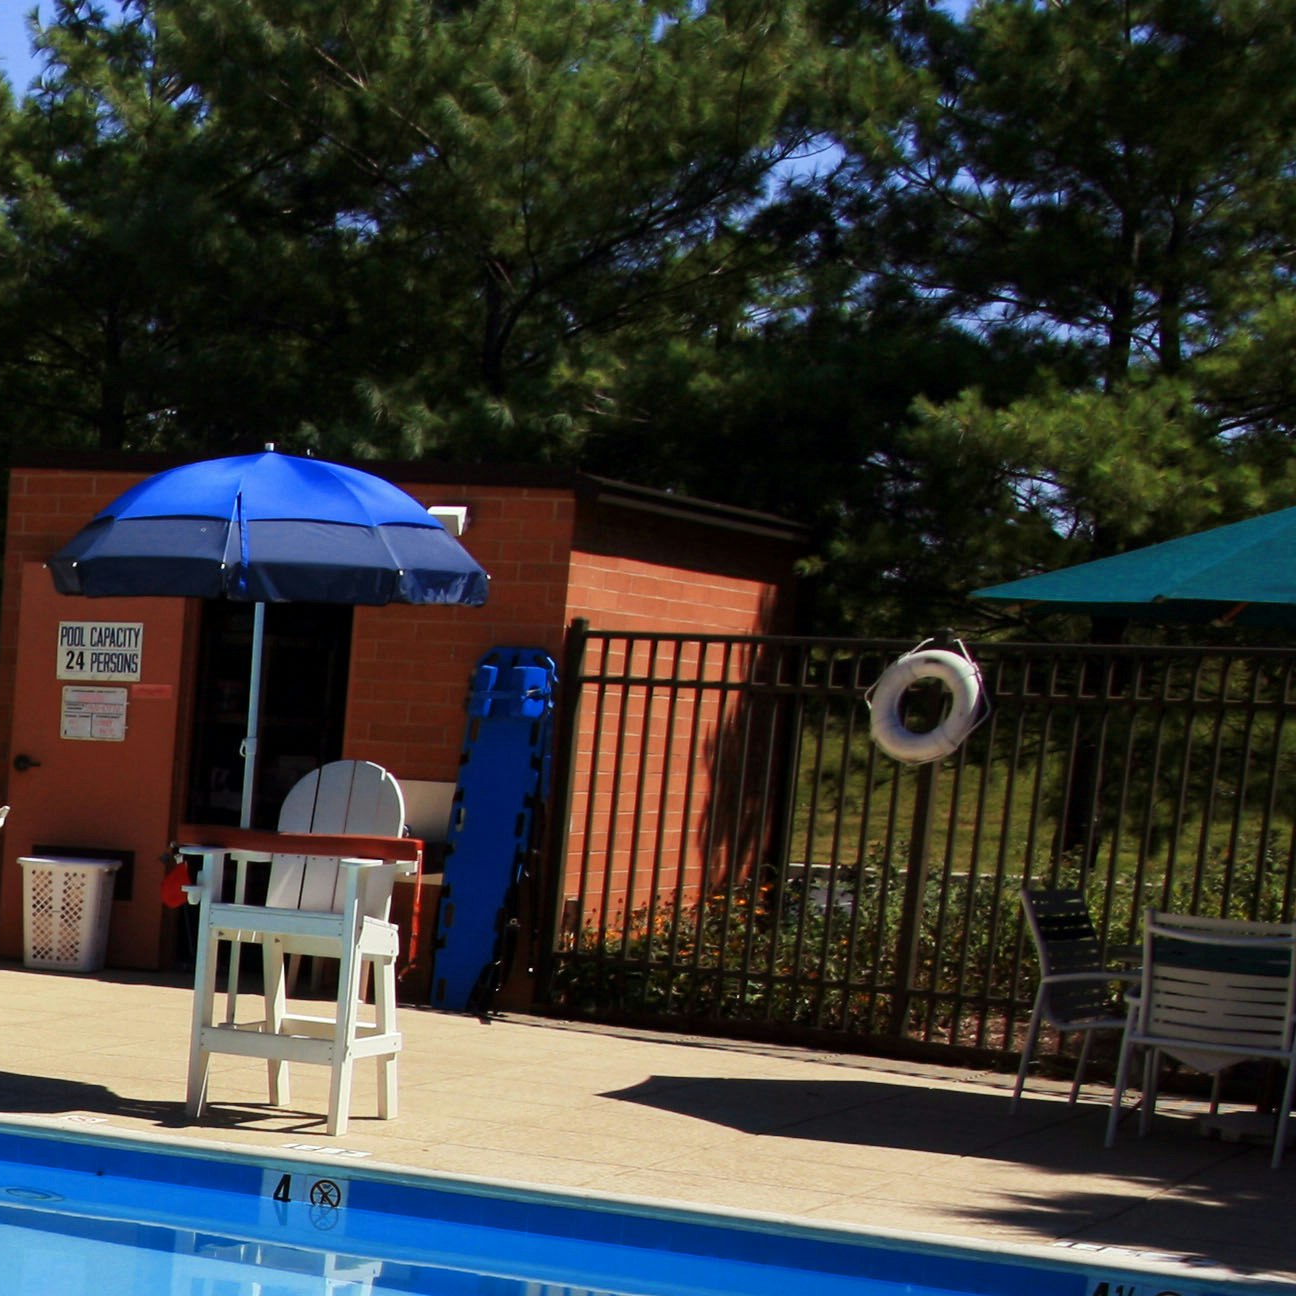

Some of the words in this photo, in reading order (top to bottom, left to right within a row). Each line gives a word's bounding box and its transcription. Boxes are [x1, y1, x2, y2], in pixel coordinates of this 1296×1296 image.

[60, 625, 86, 647] POOL
[90, 626, 141, 649] CAPACITY
[65, 650, 85, 671] 24
[90, 652, 139, 673] PERSONS
[273, 1173, 292, 1203] 4
